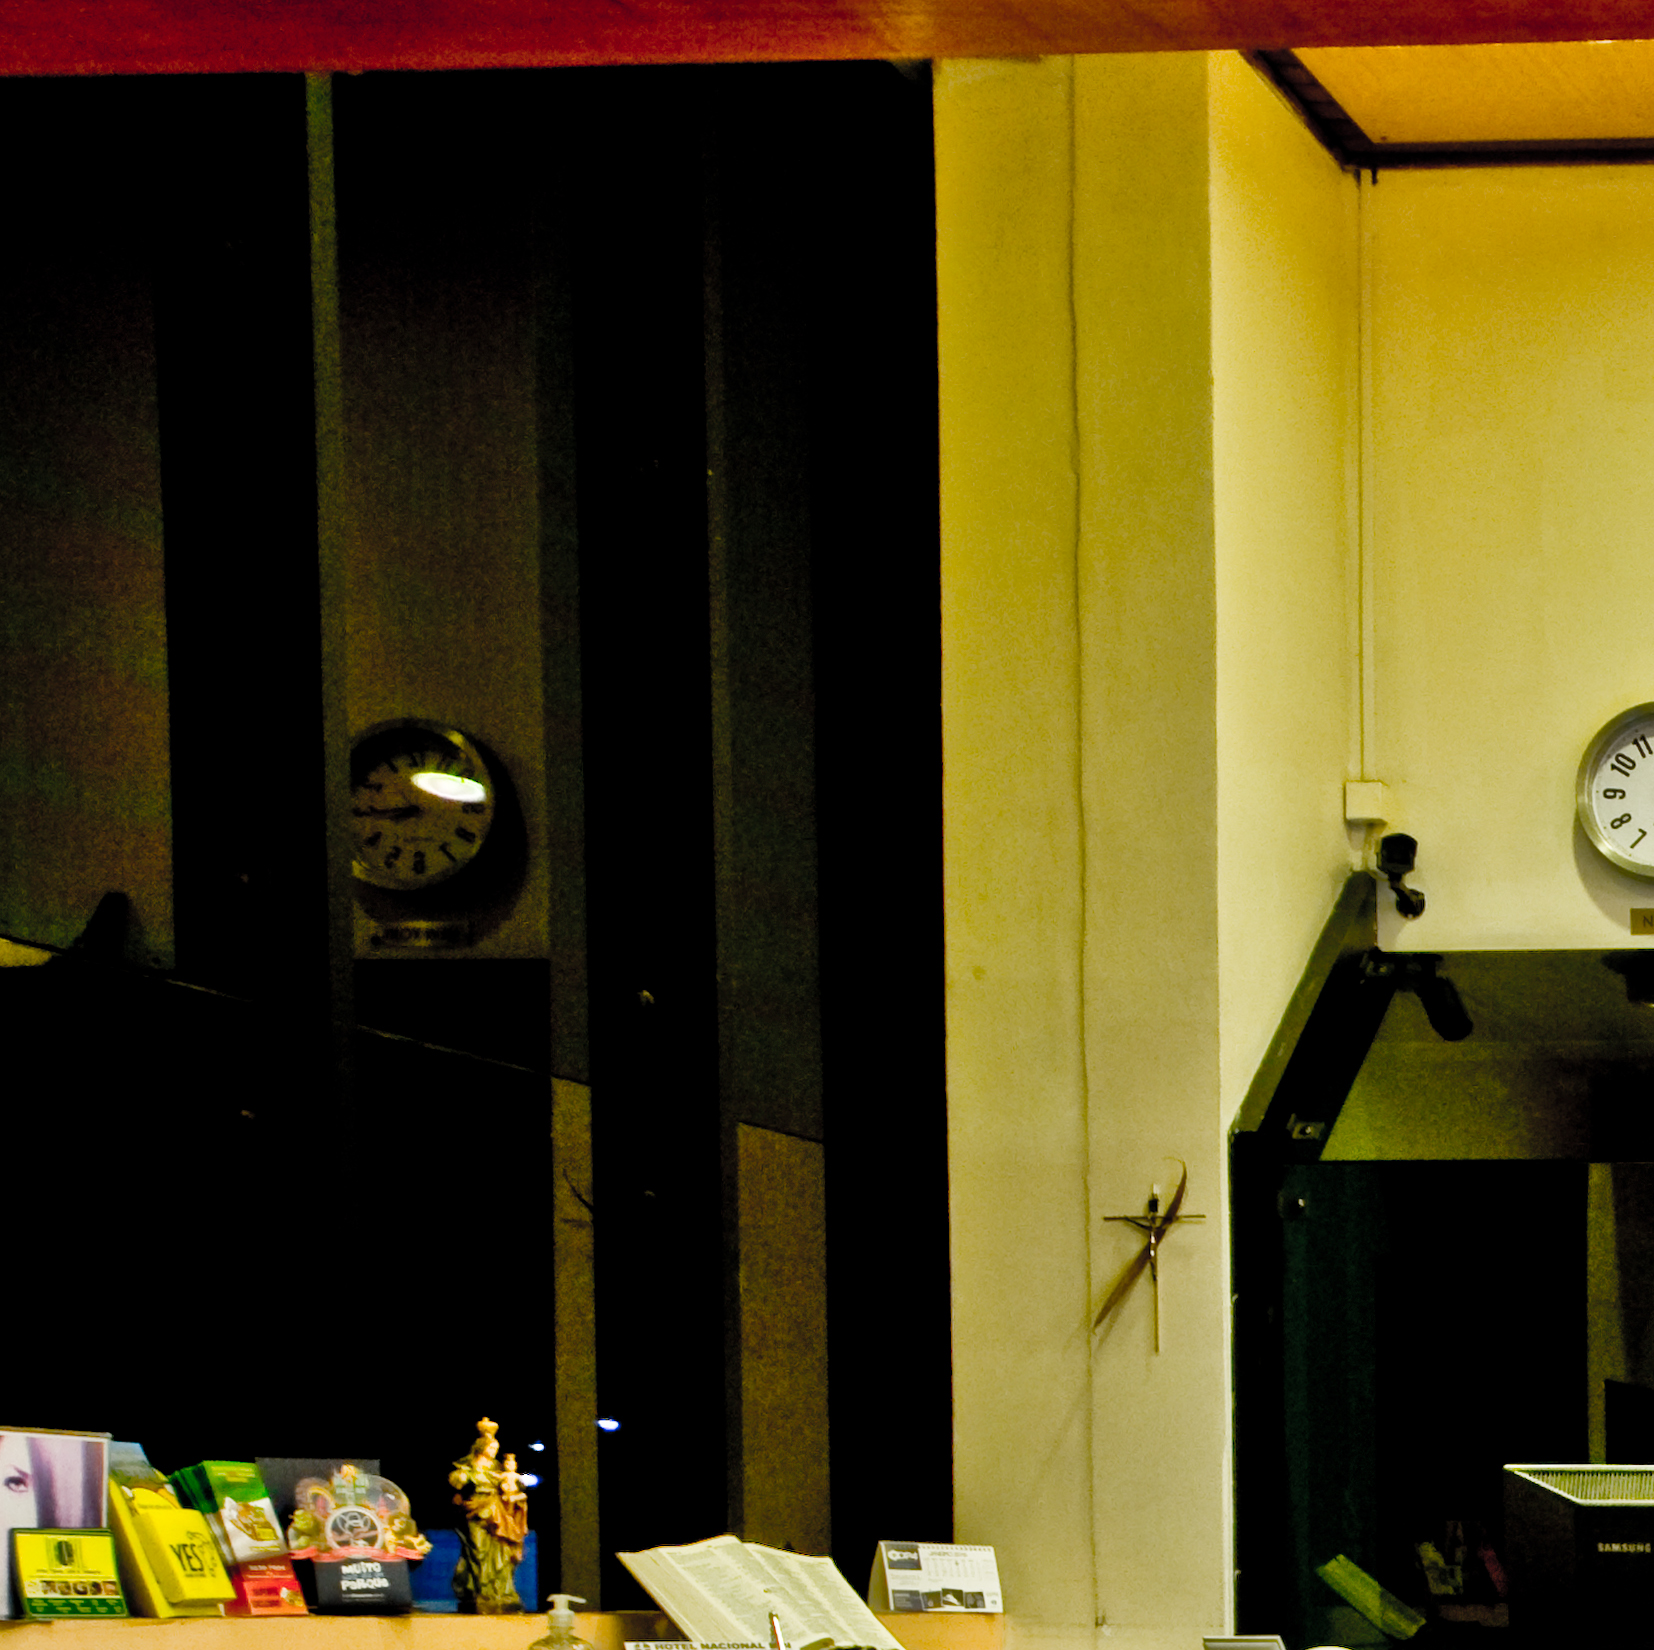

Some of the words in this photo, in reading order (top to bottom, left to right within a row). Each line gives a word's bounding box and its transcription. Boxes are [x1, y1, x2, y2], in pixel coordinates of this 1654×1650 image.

[1632, 735, 1653, 758] 11
[1611, 753, 1636, 777] 10
[1603, 788, 1626, 799] 9
[1610, 813, 1632, 829] 8
[1630, 829, 1647, 848] 7
[1597, 1542, 1652, 1553] SAMSUNG
[170, 1544, 204, 1572] YES
